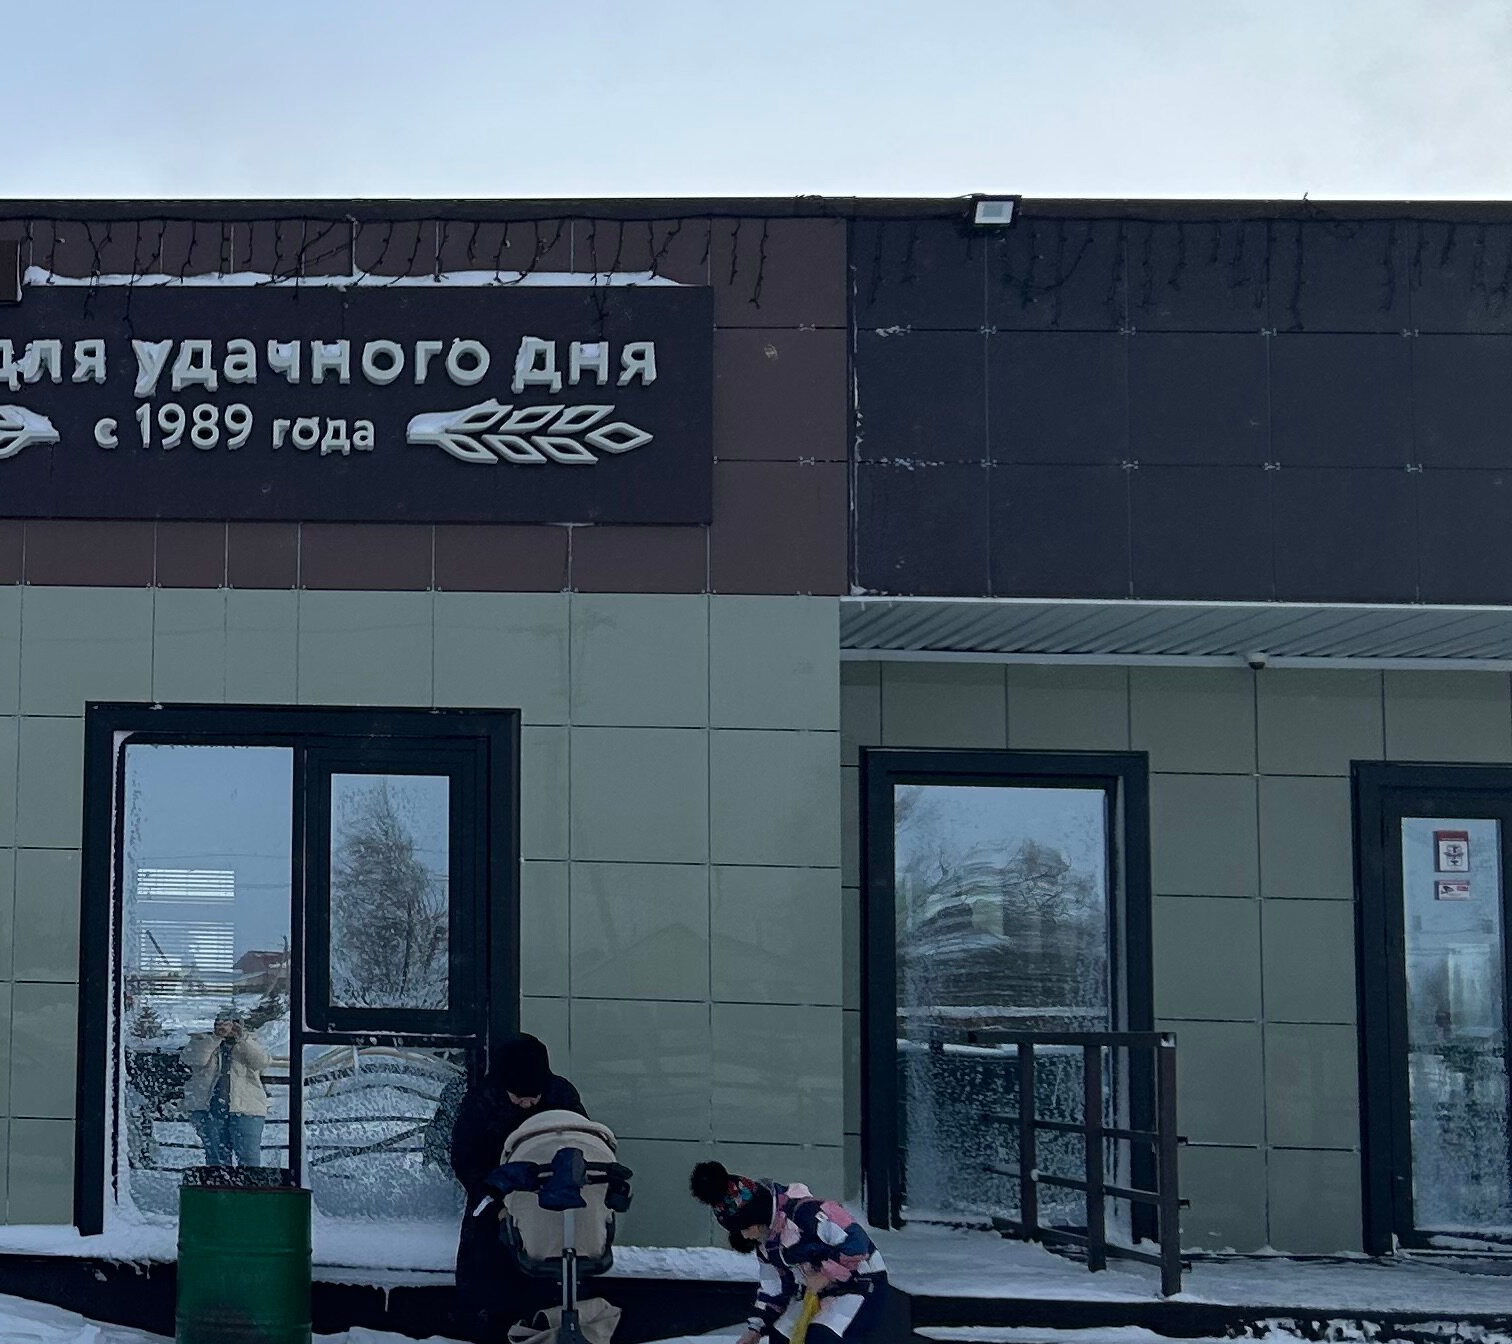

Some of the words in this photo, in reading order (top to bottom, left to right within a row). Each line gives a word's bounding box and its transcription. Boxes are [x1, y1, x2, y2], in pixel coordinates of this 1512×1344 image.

[133, 335, 491, 397] удачного
[512, 336, 658, 394] дня
[135, 402, 255, 451] 1989
[272, 415, 376, 457] года
